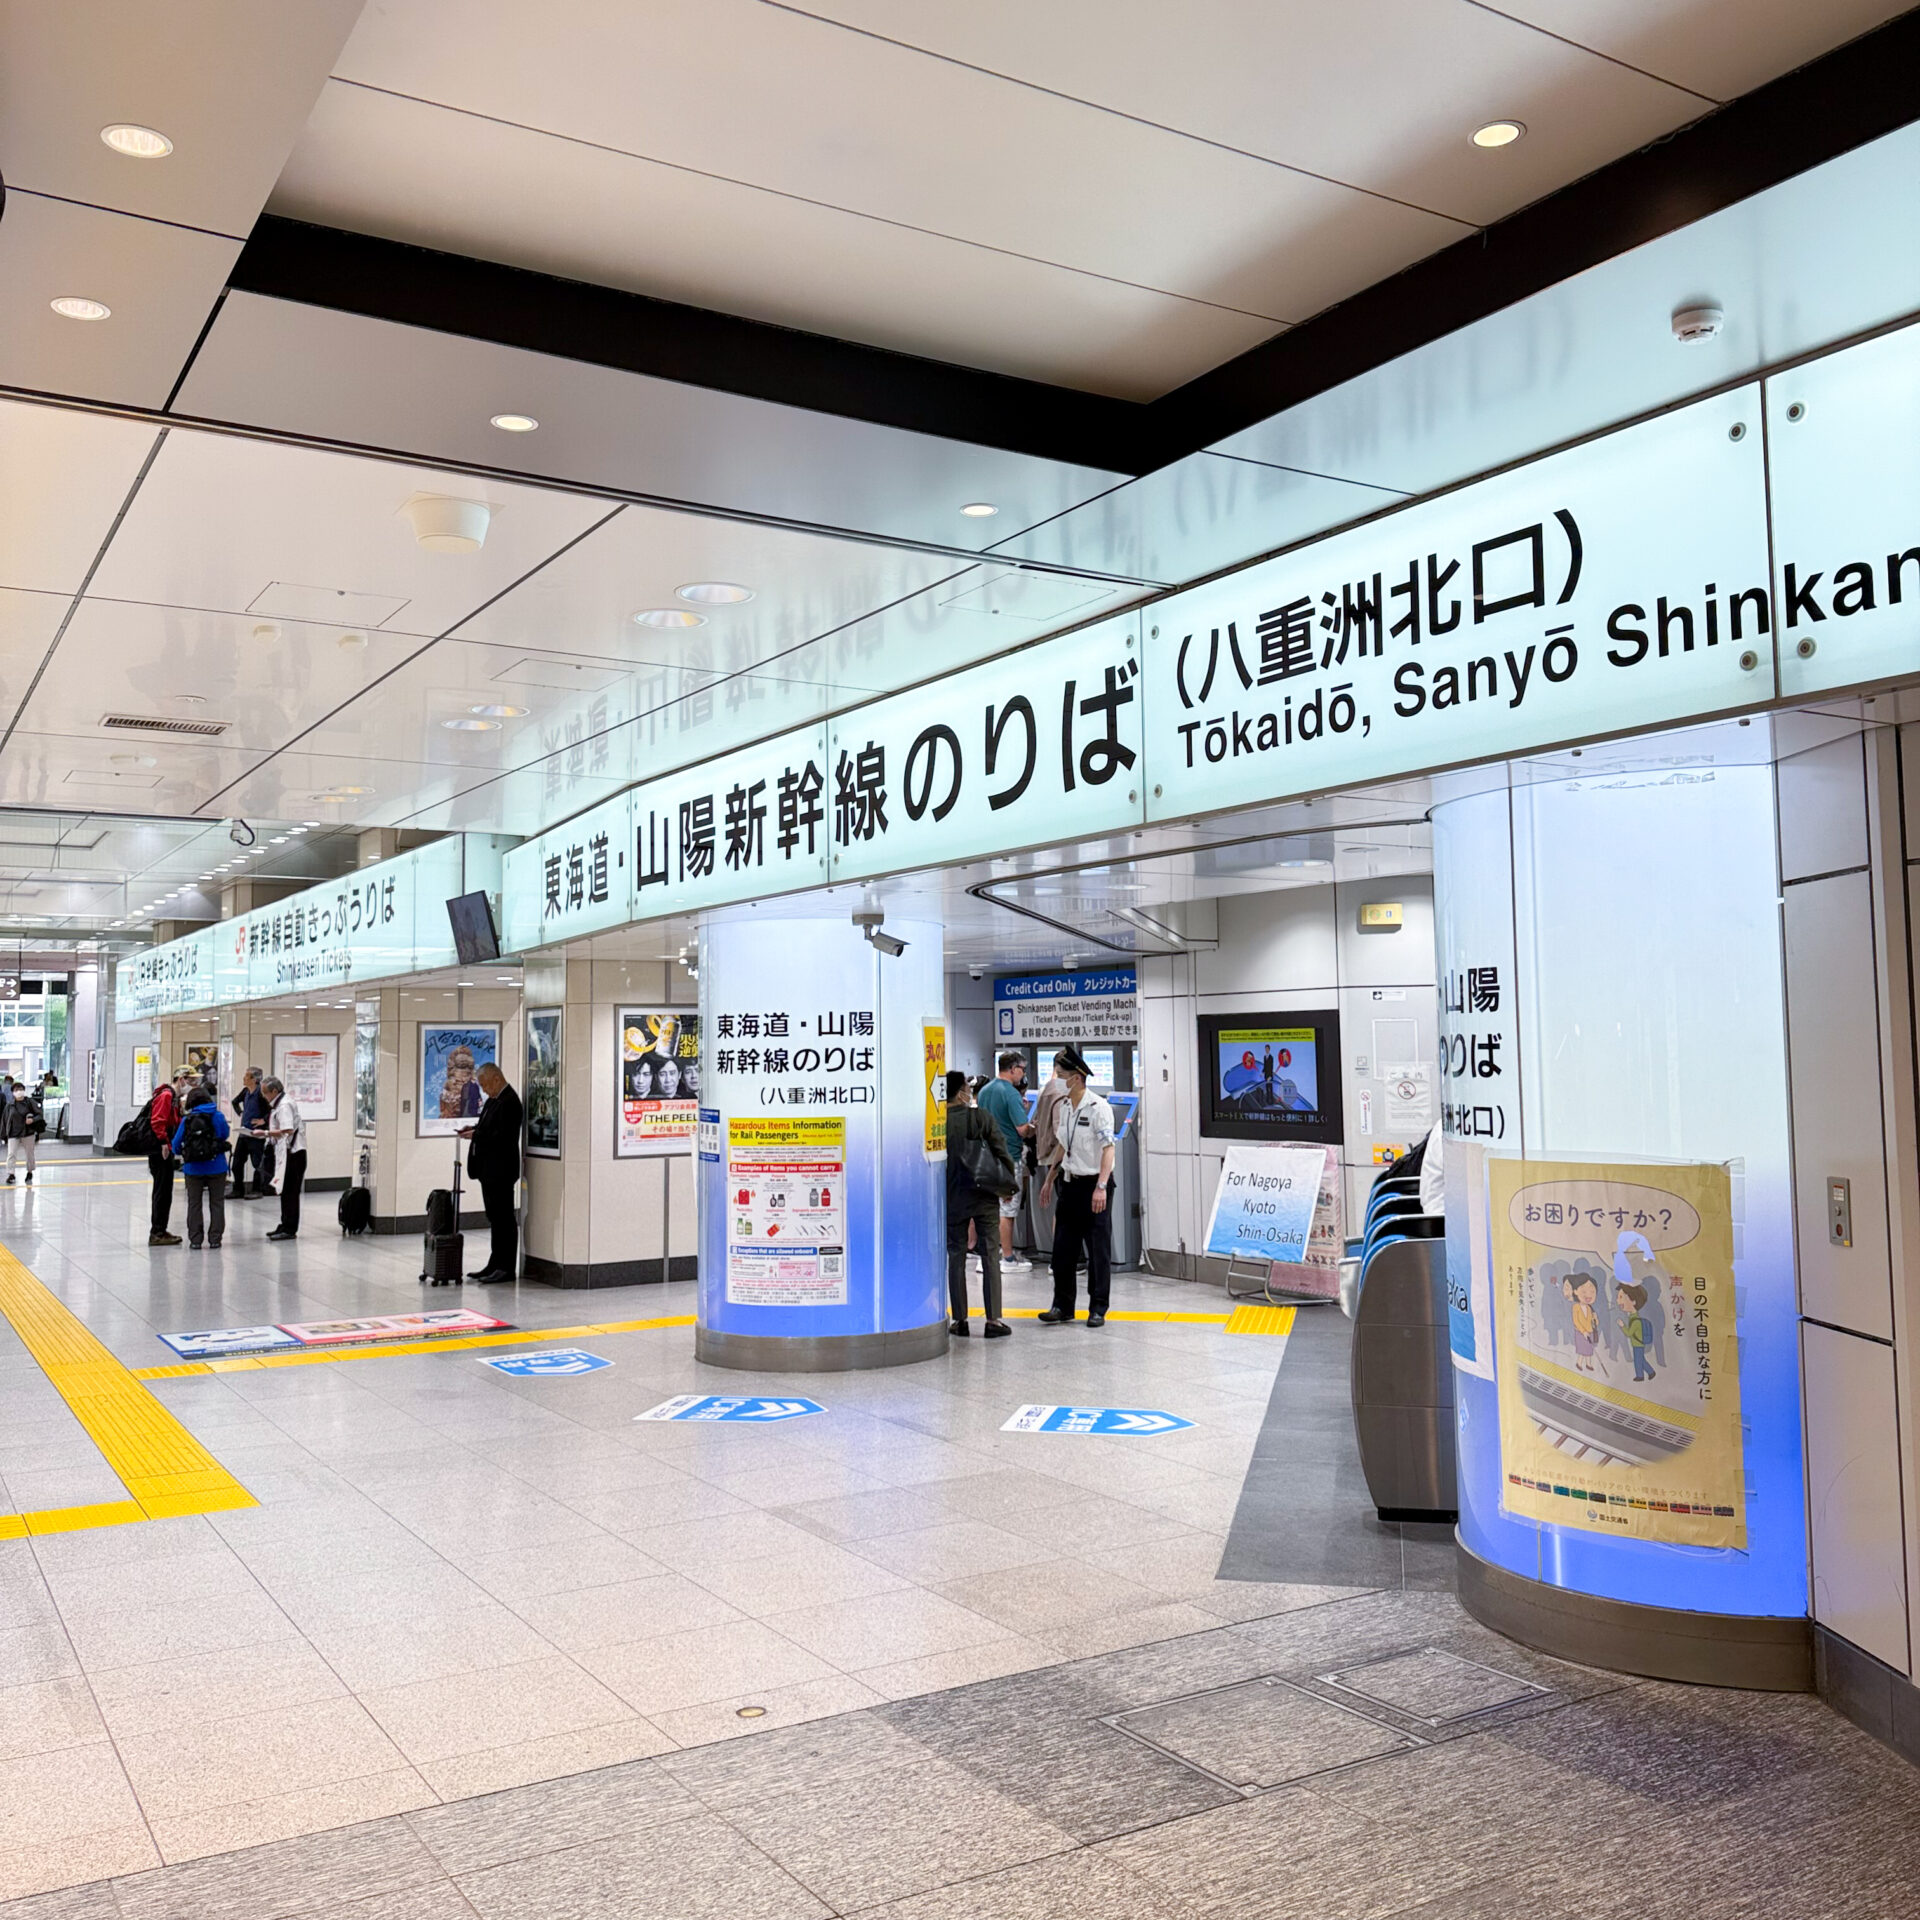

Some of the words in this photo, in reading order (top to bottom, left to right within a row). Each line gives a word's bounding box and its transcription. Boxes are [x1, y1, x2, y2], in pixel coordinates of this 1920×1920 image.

[1177, 683, 1372, 768] Tōkaidō,
[1393, 625, 1578, 708] Sanyō
[544, 657, 1138, 920] 東海道・山陽新幹線のりば
[1005, 981, 1031, 996] Credit
[1033, 979, 1053, 994] Card
[1055, 979, 1076, 995] Only
[1017, 1003, 1056, 1014] Shinkansen
[1057, 1002, 1080, 1012] Ticket
[1081, 1000, 1111, 1013] Vending
[717, 1011, 874, 1039] 東海道・山陽
[717, 1047, 874, 1075] 新幹線のりば
[760, 1086, 876, 1104] (八重洲北口)
[730, 1121, 766, 1130] Hazardous
[768, 1121, 790, 1130] Items
[792, 1120, 842, 1130] Information
[730, 1131, 739, 1139] for
[740, 1131, 753, 1139] Rail
[755, 1131, 799, 1141] Passengers
[820, 1164, 836, 1172] carry
[1227, 1171, 1246, 1186] For
[1249, 1173, 1292, 1192] Nagoya
[1243, 1198, 1276, 1217] Kyoto
[1236, 1223, 1304, 1245] Shin-Osaka
[1669, 1276, 1685, 1337] 声かけを
[1694, 1277, 1712, 1400] 目の不自由な方に
